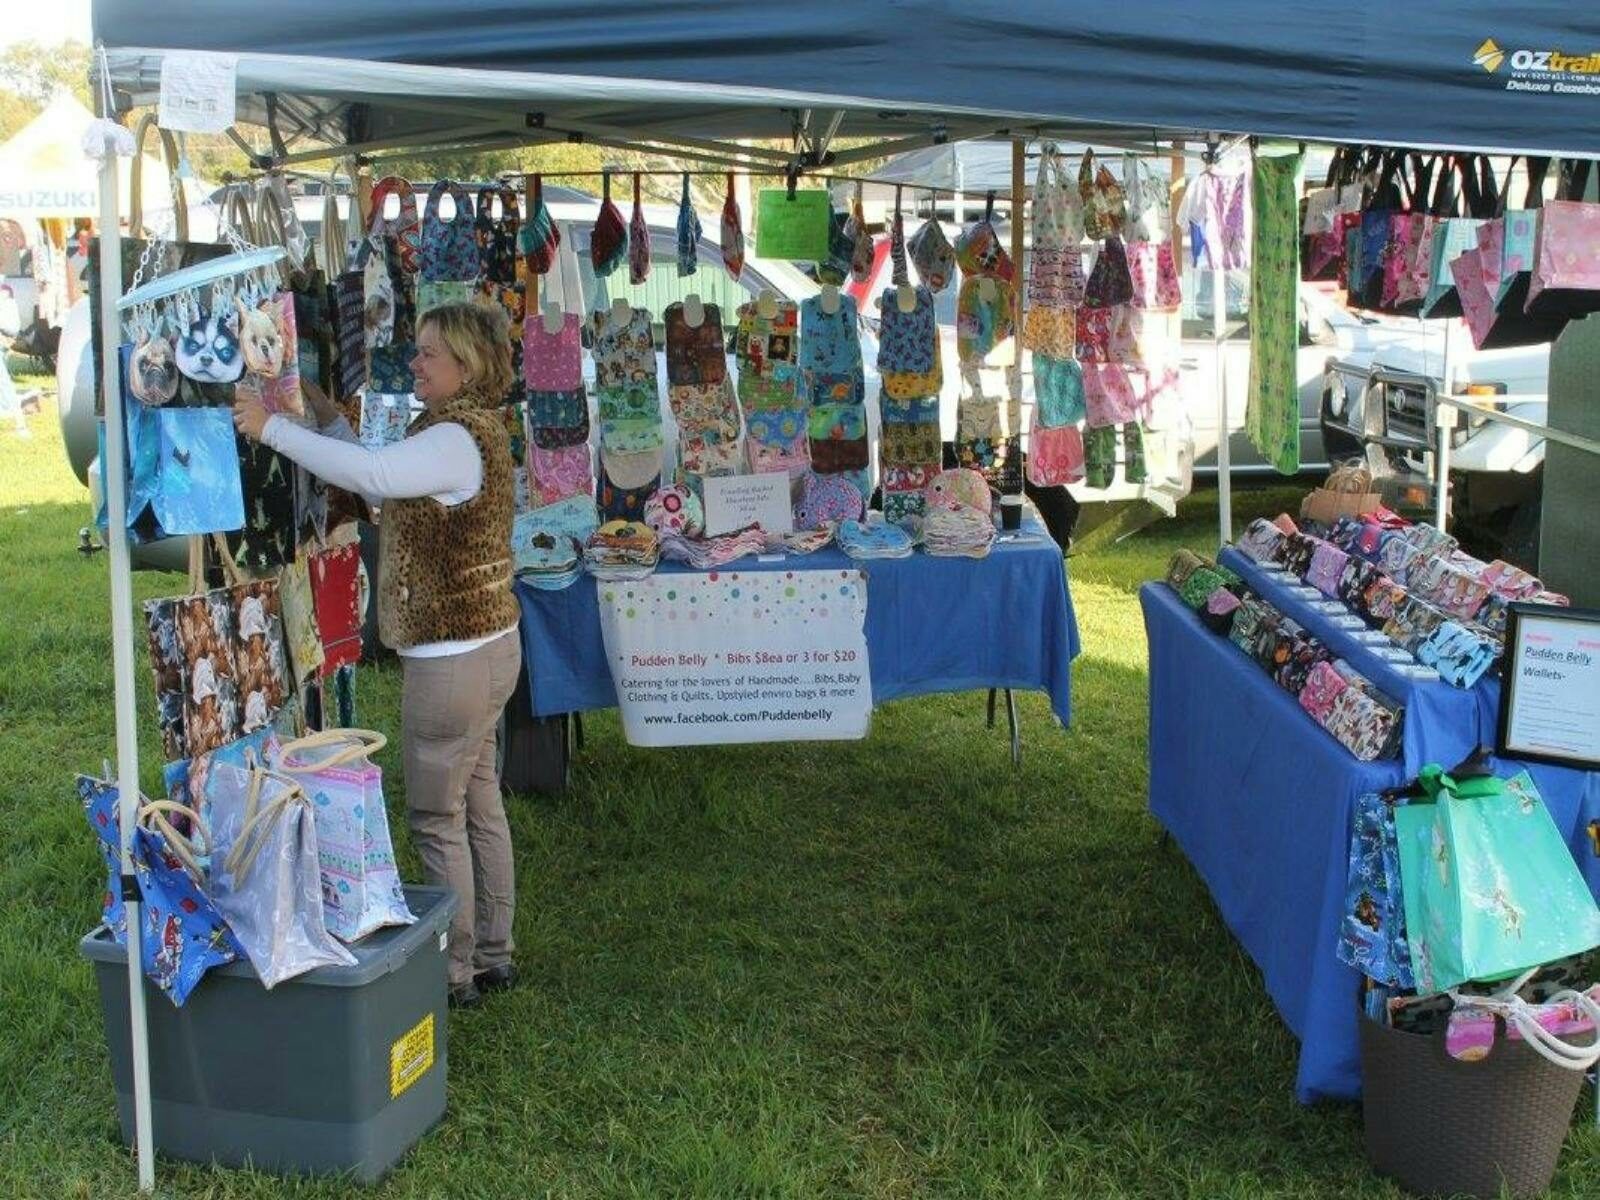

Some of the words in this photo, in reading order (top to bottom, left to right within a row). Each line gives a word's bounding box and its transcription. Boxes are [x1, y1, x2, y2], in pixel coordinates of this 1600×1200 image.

[1506, 80, 1551, 92] Deluxe
[1553, 82, 1600, 95] Gazebo
[0, 191, 96, 208] SUZUKI
[631, 655, 675, 667] Pudden
[679, 653, 707, 667] Belly
[727, 652, 751, 664] Bibs
[755, 651, 783, 664] $8ea
[786, 653, 798, 663] or
[803, 651, 810, 663] 3
[813, 650, 830, 663] for
[833, 649, 856, 663] $20
[1525, 646, 1564, 662] Pudden
[1567, 651, 1592, 666] Belly
[621, 679, 662, 690] Catering
[666, 678, 679, 688] for
[682, 678, 699, 688] the
[702, 677, 731, 688] lovers
[735, 676, 744, 687] of
[627, 692, 667, 703] Clothing
[671, 691, 678, 701] &
[717, 688, 759, 701] Upstyled
[762, 688, 792, 700] enviro
[795, 688, 817, 700] bags
[819, 687, 826, 697] &
[831, 688, 855, 698] more
[644, 709, 832, 725] www.facebook.com/Puddenbelly
